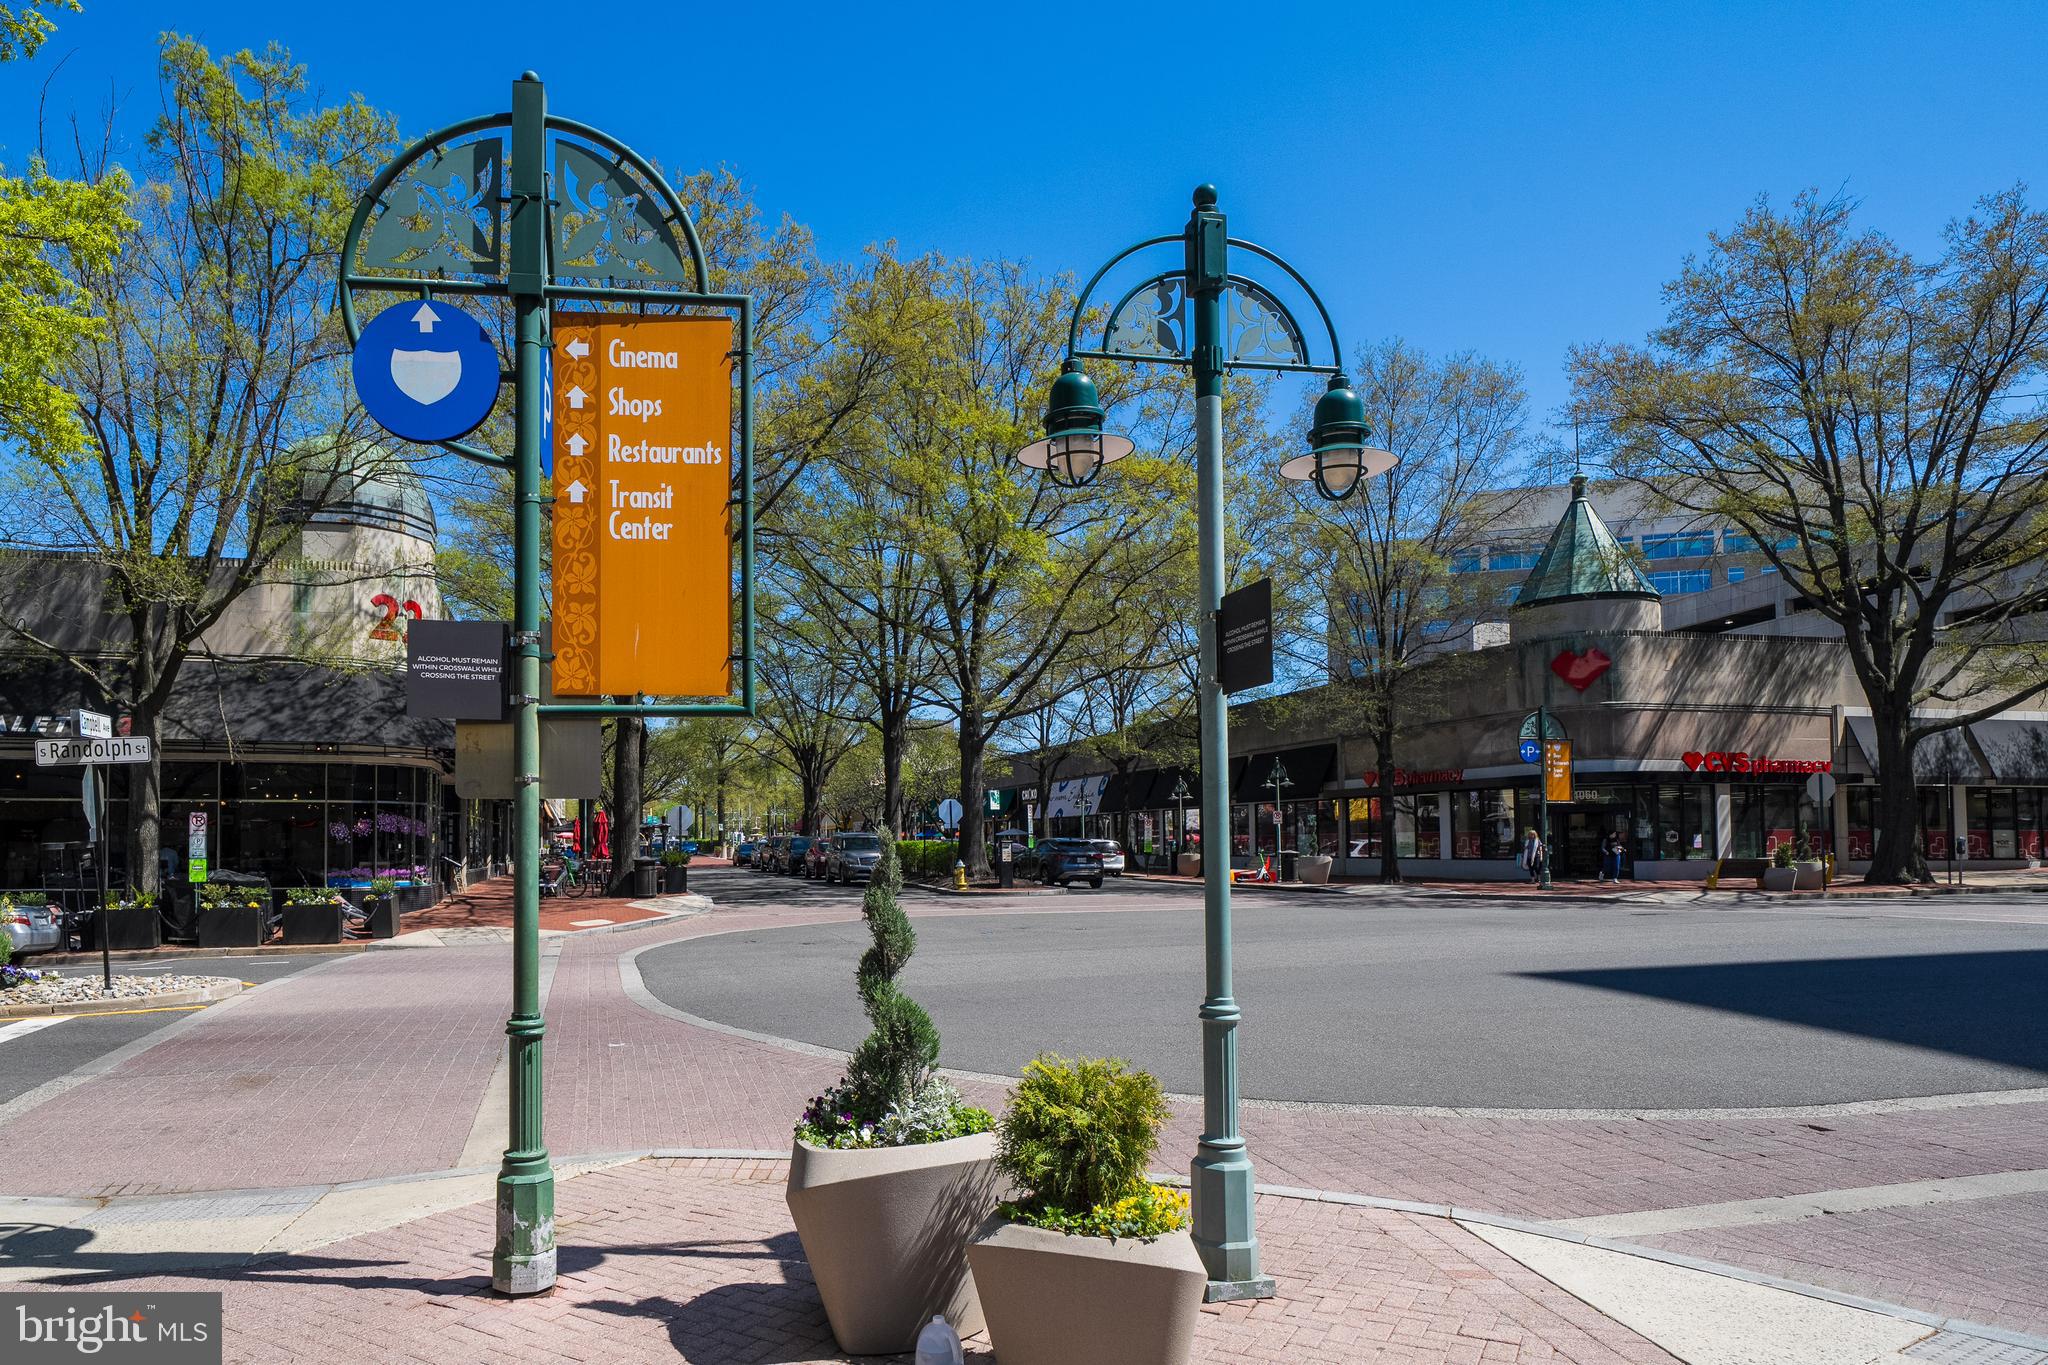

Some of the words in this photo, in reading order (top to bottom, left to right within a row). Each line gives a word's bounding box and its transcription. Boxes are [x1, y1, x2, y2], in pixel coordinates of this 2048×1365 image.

[609, 338, 678, 369] Cinema
[608, 387, 662, 423] Shops
[608, 434, 722, 464] Restaurants
[609, 479, 674, 509] Transit
[609, 511, 674, 540] Center
[412, 663, 438, 671] WITHIN
[438, 664, 481, 673] CROSSWALK
[481, 666, 502, 674] WHILE
[417, 655, 451, 663] ALCOHOL
[420, 672, 456, 680] CROSSING
[40, 748, 47, 758] S
[50, 739, 132, 761] Randolph
[1527, 746, 1535, 757] P
[1704, 751, 1751, 773] CVS
[1751, 755, 1832, 776] pharmacy
